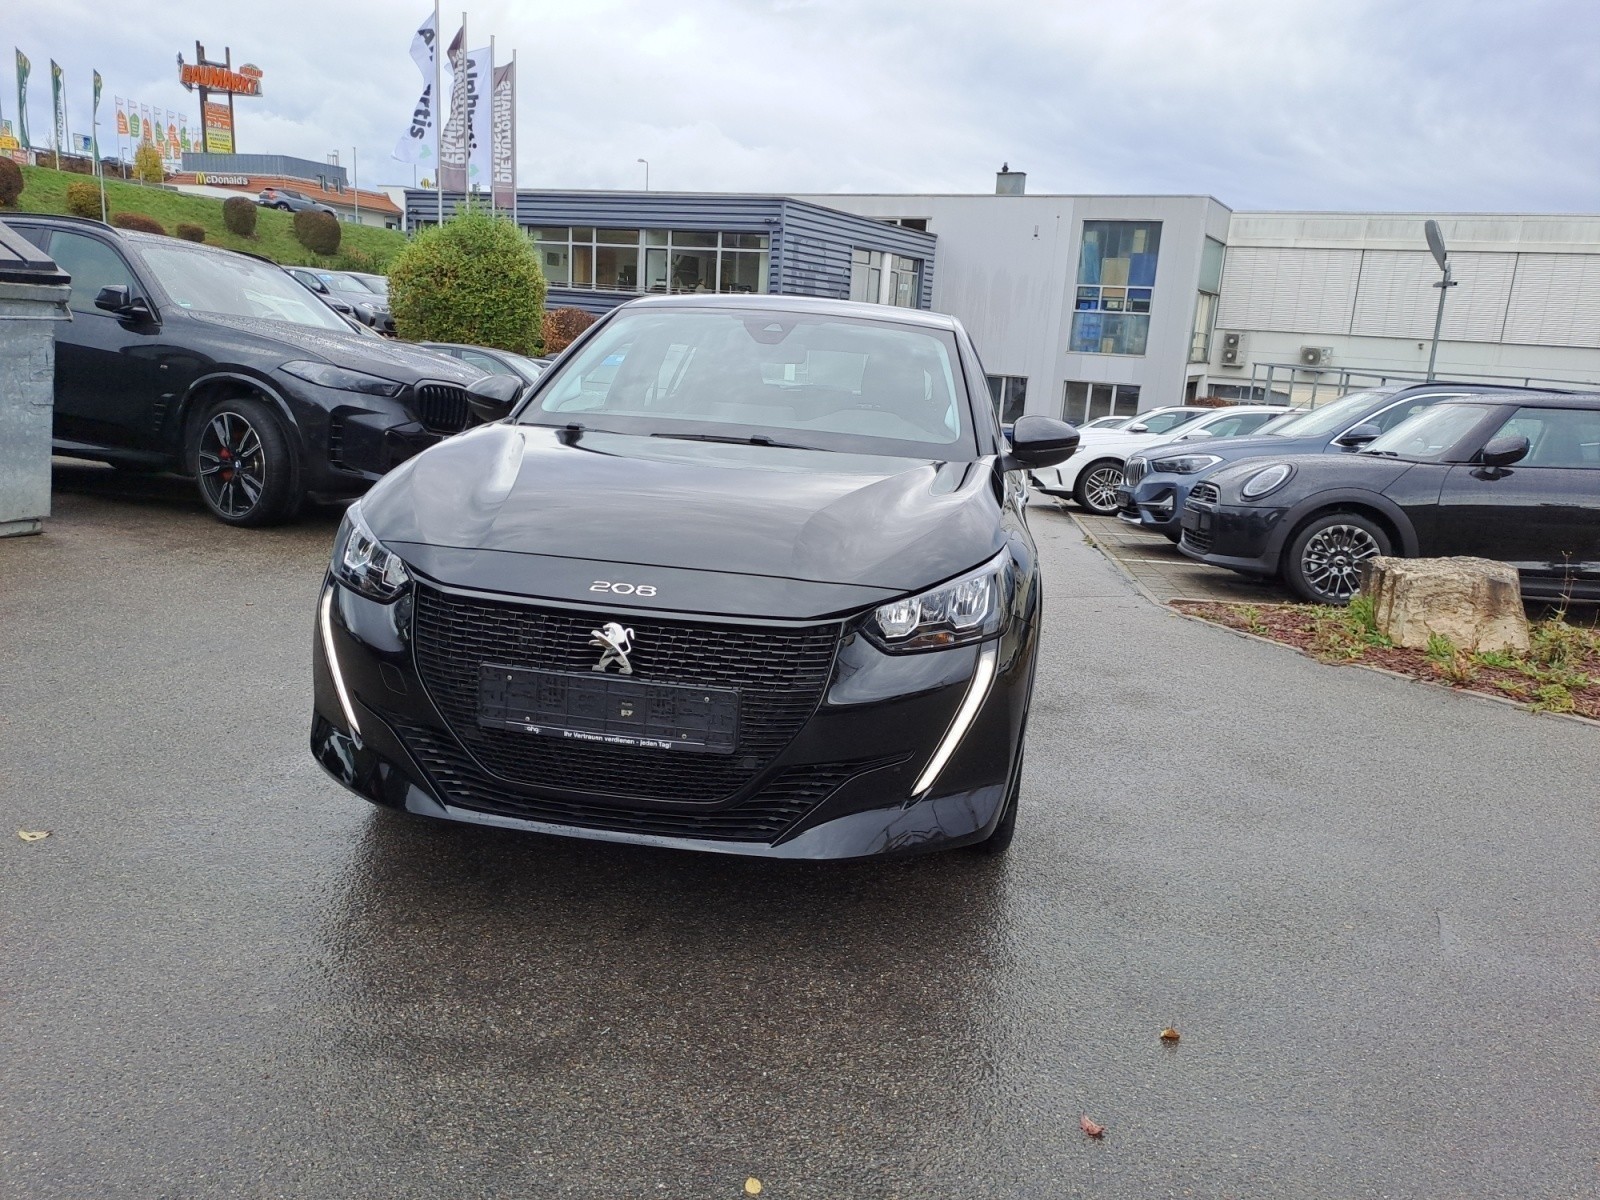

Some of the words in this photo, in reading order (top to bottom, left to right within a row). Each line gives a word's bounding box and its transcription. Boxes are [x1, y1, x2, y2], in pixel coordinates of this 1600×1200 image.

[181, 64, 258, 95] BAUMARKT
[195, 172, 249, 186] McDonald's
[589, 580, 657, 597] 208
[573, 731, 603, 741] Vertrauen
[604, 735, 635, 744] verdienen
[639, 738, 658, 747] jeden
[658, 740, 672, 749] Tag!
